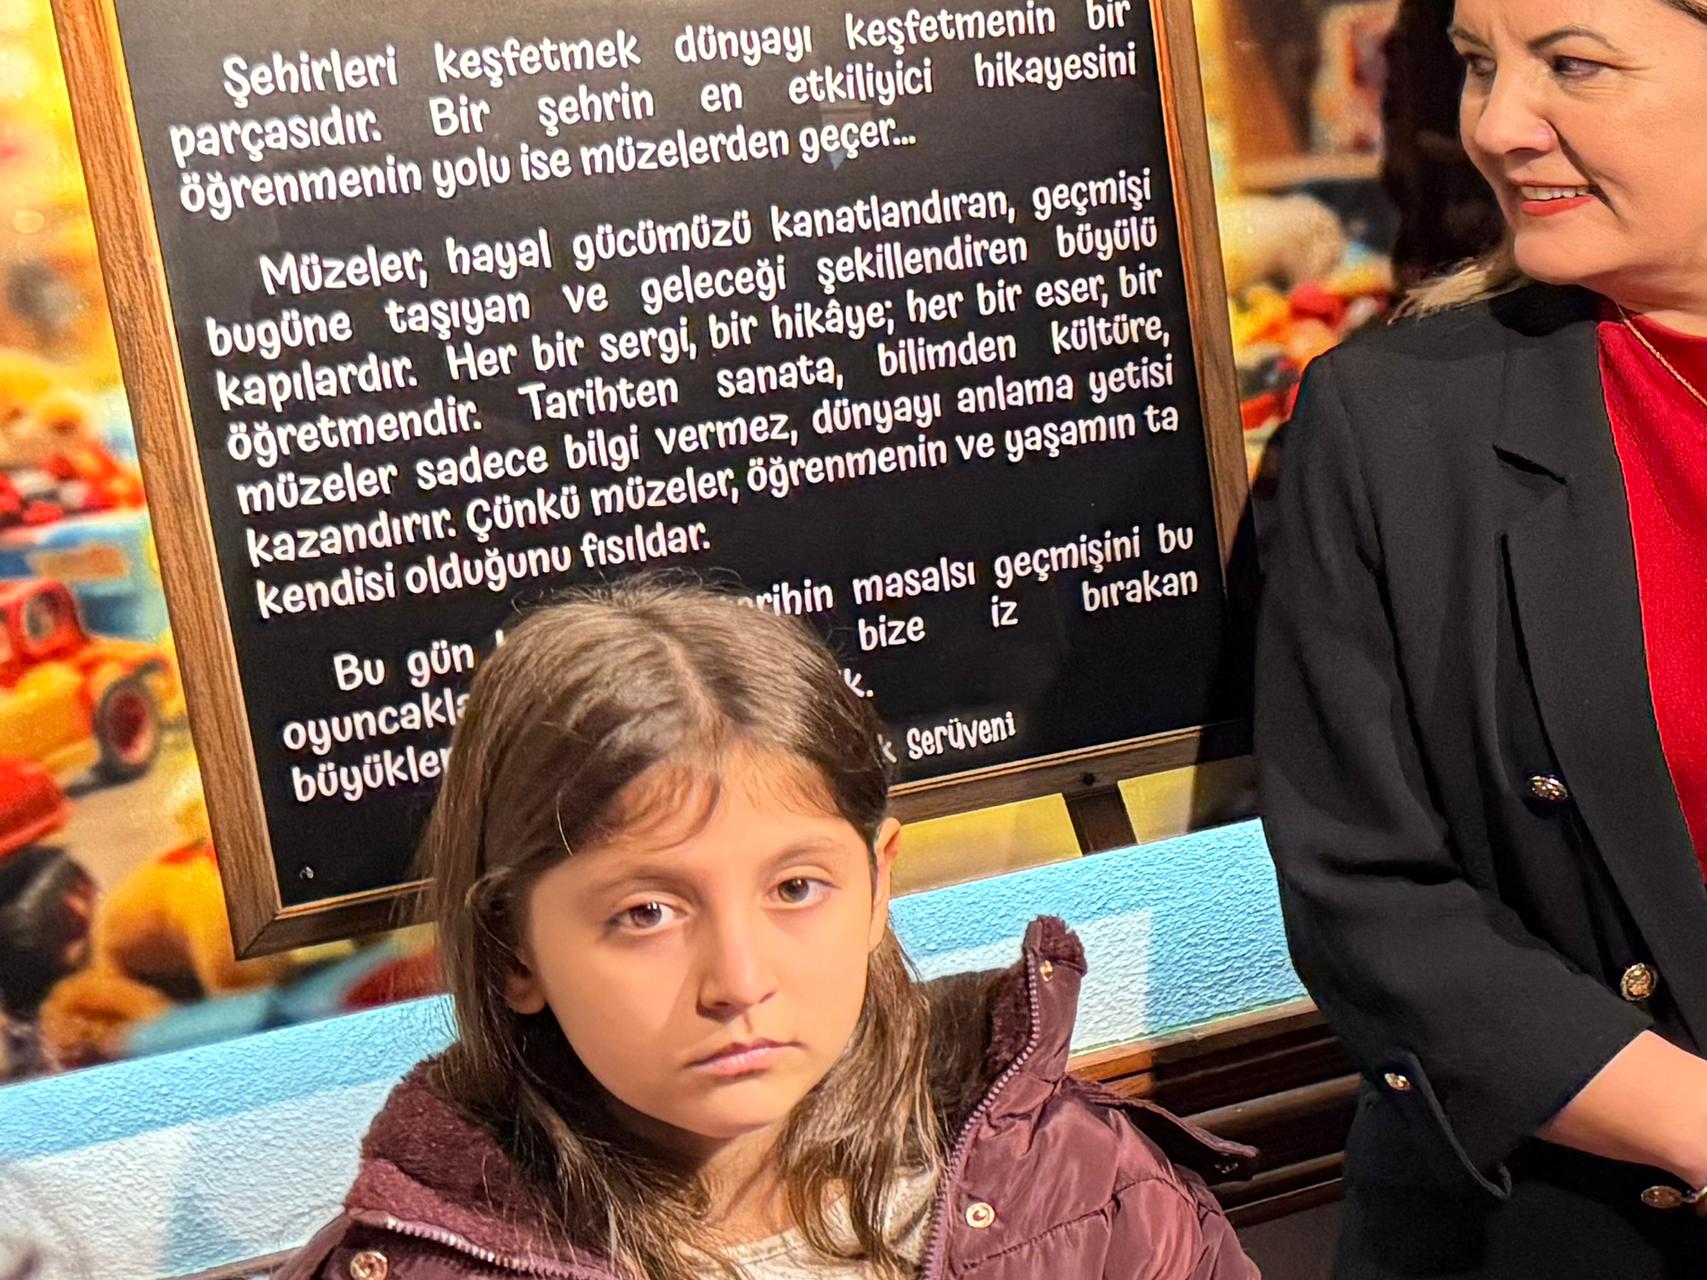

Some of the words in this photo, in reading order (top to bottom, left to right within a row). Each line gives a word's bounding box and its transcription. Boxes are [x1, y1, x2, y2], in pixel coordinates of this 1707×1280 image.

[170, 104, 382, 168] parçasıdır.
[428, 93, 491, 137] Bir
[537, 81, 654, 137] şehrin
[700, 82, 743, 113] en
[788, 56, 933, 107] etkiliyici
[974, 40, 1137, 91] hikayesini
[223, 44, 398, 109] Şehirleri
[434, 29, 642, 88] keşfetmek
[674, 24, 812, 67] dünyayı
[845, 0, 1056, 56] keşfetmenin
[179, 153, 422, 222] öğrenmenin
[432, 145, 511, 199] yolu
[520, 142, 572, 182] ise
[579, 123, 790, 176] müzelerden
[797, 117, 917, 163] geçer...
[258, 244, 428, 296] Müzeler,
[445, 226, 552, 280] hayal
[573, 208, 752, 272] gücümüzü
[770, 188, 1016, 243] kanatlandıran,
[1031, 167, 1151, 222] geçmişi
[205, 308, 353, 360] bugüne
[383, 291, 530, 341] taşıyan
[561, 282, 609, 314] ve
[640, 253, 787, 316] geleceği
[816, 233, 1028, 295] şekillendiren
[1055, 215, 1157, 262] büyülü
[215, 351, 418, 413] kapılardır.
[445, 340, 518, 381] Her
[531, 329, 585, 374] bir
[599, 315, 697, 365] sergi,
[708, 309, 759, 350] bir
[770, 298, 895, 340] hikâye;
[906, 288, 965, 324] her
[976, 278, 1023, 316] bir
[1035, 274, 1109, 309] eser,
[1118, 262, 1163, 299] bir
[226, 394, 482, 469] öğretmendir.
[517, 375, 679, 421] Tarihten
[716, 354, 844, 399] sanata,
[877, 330, 1017, 377] bilimden
[1050, 313, 1170, 355] kültüre,
[235, 461, 398, 515] müzeler
[415, 444, 550, 491] sadece
[563, 423, 640, 472] bilgi
[654, 413, 798, 455] vermez,
[812, 392, 942, 435] dünyayı
[957, 373, 1074, 414] anlama
[1088, 352, 1173, 404] yetisi
[245, 507, 457, 568] kazandırır.
[465, 484, 581, 543] Çünkü
[589, 466, 739, 517] müzeler,
[746, 433, 948, 499] öğrenmenin
[954, 432, 996, 461] ve
[1004, 413, 1136, 463] yaşamın
[1143, 404, 1179, 433] ta
[255, 560, 396, 619] kendisi
[404, 545, 572, 594] olduğunu
[579, 521, 711, 568] fısıldar.
[333, 652, 386, 691] Bu
[406, 639, 475, 688] gün
[730, 578, 834, 618] rihin
[852, 556, 976, 605] masalsı
[993, 525, 1141, 589] geçmişini
[1157, 522, 1194, 554] bu
[857, 614, 926, 651] bize
[991, 594, 1019, 628] iz
[1081, 569, 1198, 612] bırakan
[906, 710, 1017, 760] Serüveni
